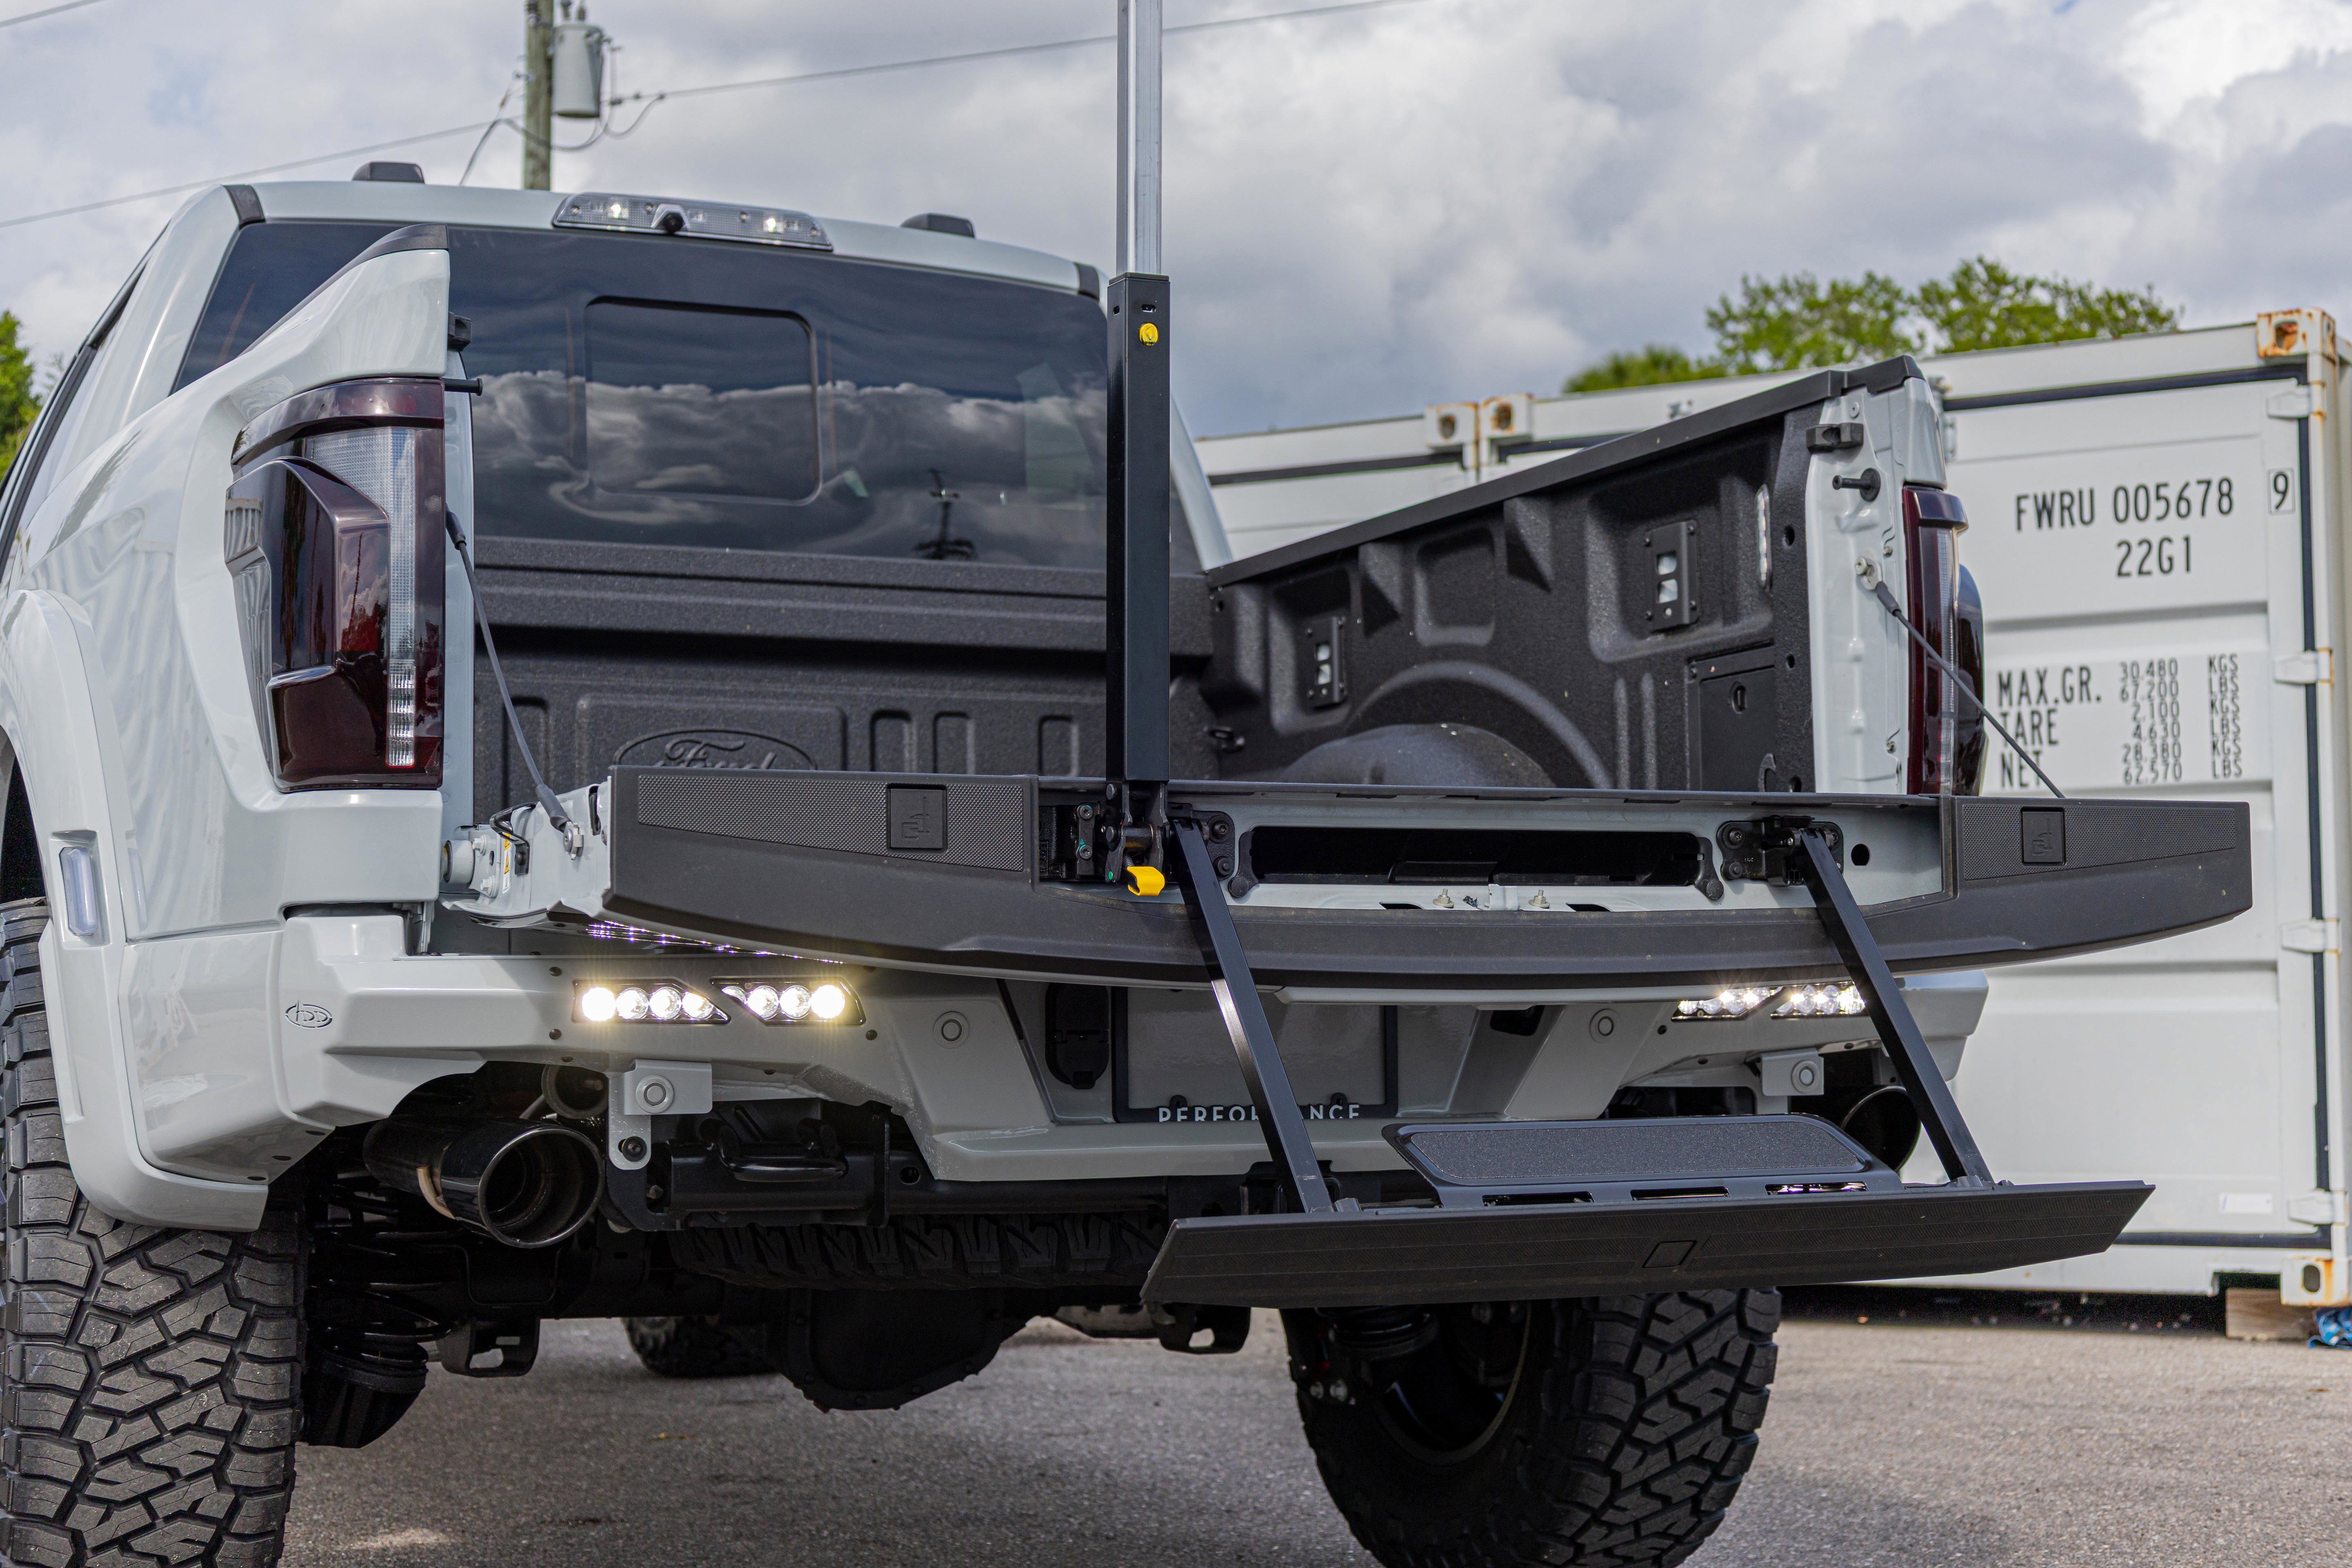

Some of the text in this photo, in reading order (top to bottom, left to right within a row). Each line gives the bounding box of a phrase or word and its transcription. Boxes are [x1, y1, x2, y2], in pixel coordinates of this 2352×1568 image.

[2015, 472, 2289, 532] FWRU 005678 9
[2116, 536, 2192, 577] 22G1
[1998, 665, 2102, 707] MAX.GR.
[2208, 653, 2238, 674] KGS
[2209, 675, 2239, 694] LBS
[2000, 708, 2059, 747] TARE
[2209, 695, 2240, 715] KGS
[2210, 716, 2241, 735] LBS
[2001, 751, 2042, 788] NET
[2212, 737, 2242, 757] KGS
[2212, 757, 2243, 779] LBS
[1158, 1105, 1359, 1122] PERFONCE
